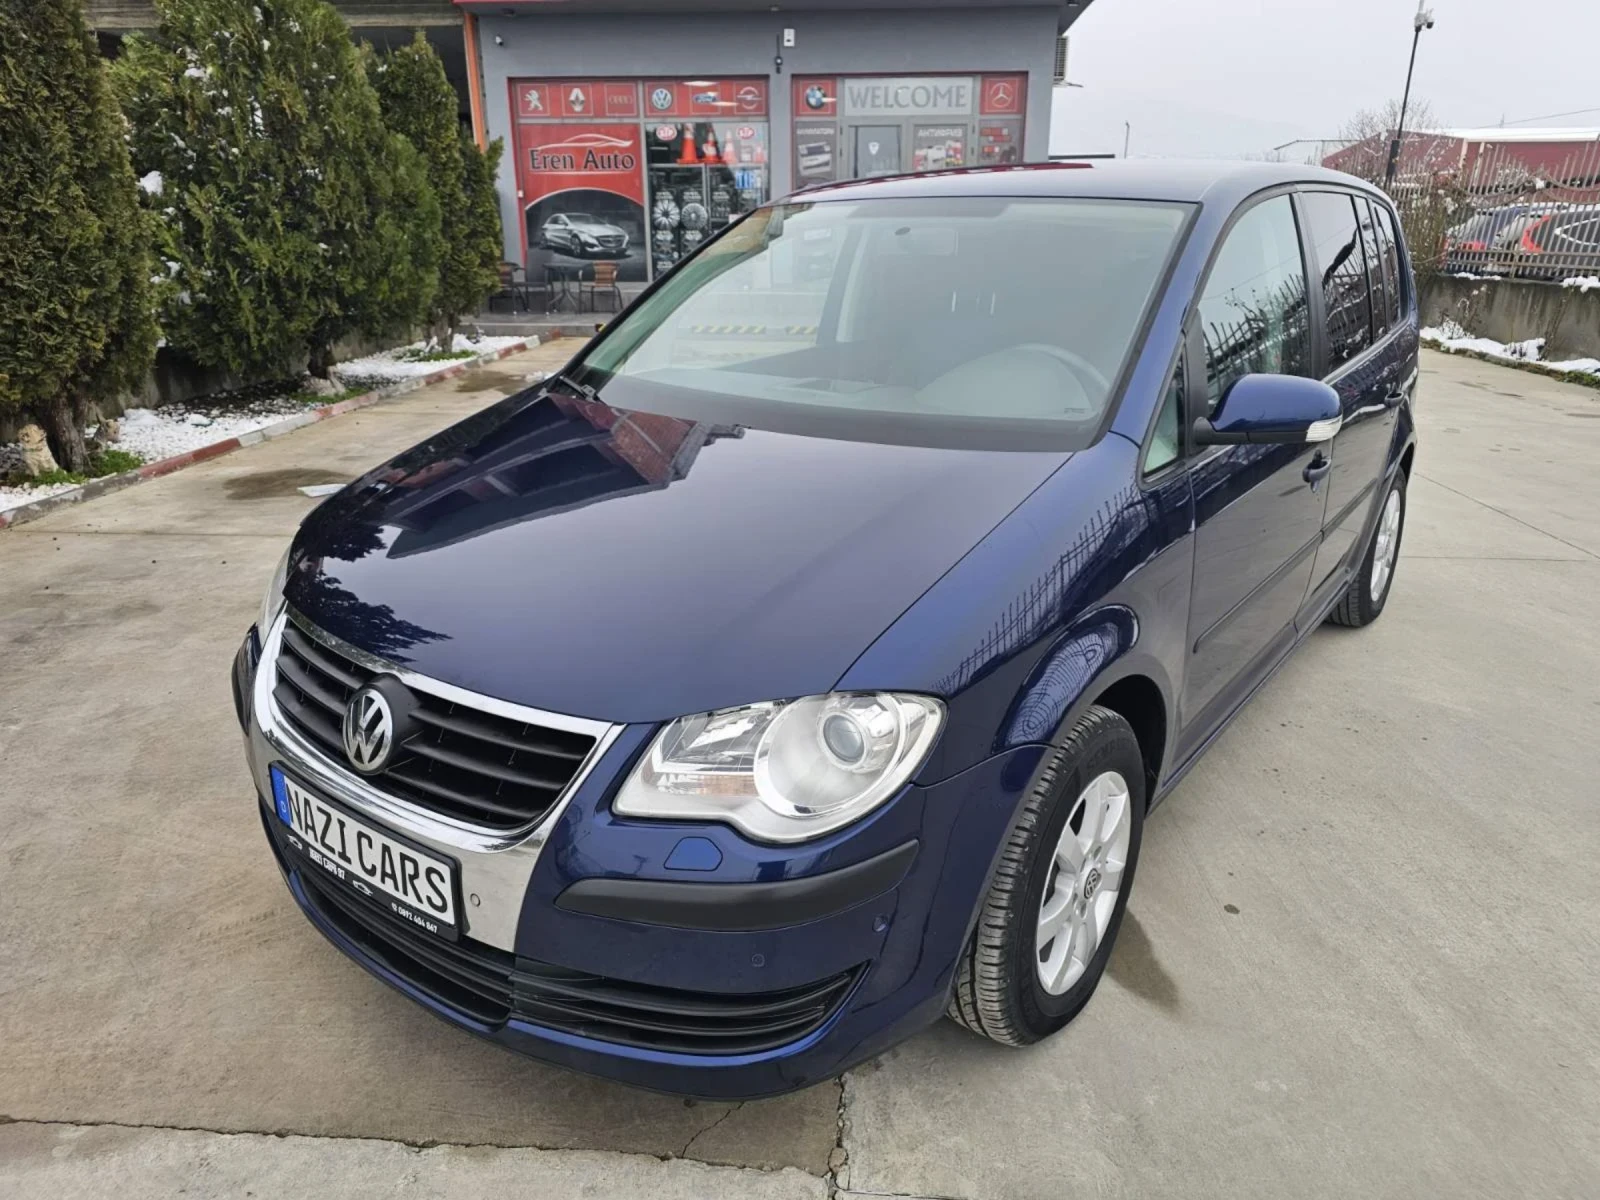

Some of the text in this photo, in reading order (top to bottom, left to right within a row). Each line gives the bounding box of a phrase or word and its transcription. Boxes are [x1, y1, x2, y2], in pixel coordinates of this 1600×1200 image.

[849, 85, 967, 109] WELCOME
[529, 148, 634, 170] Eren Auto
[286, 783, 448, 914] NAZI CARS
